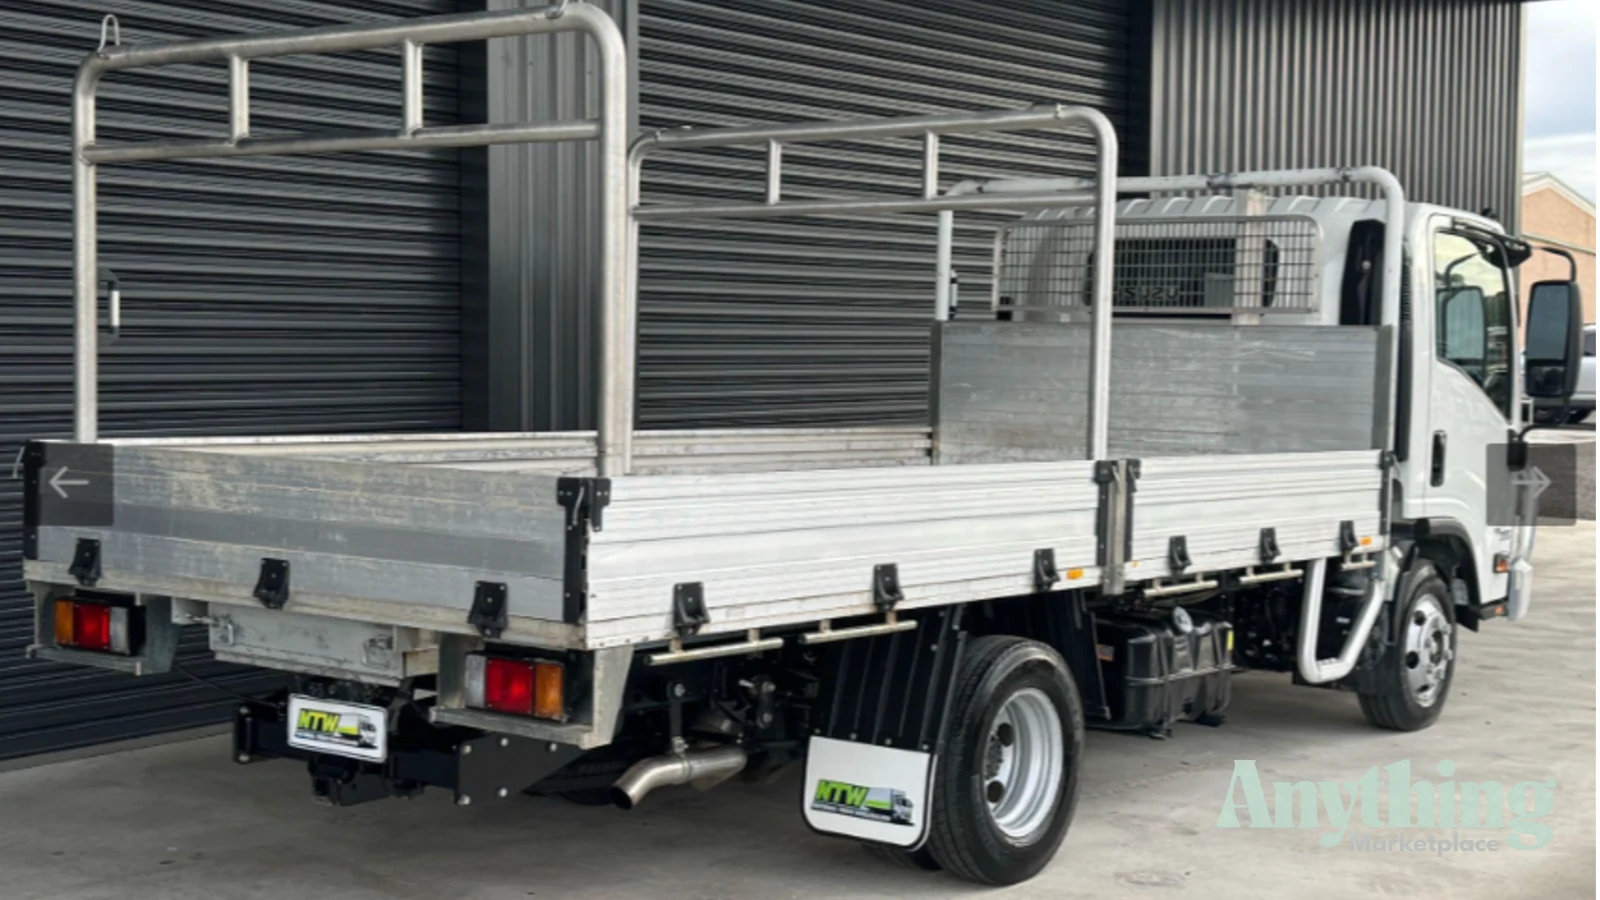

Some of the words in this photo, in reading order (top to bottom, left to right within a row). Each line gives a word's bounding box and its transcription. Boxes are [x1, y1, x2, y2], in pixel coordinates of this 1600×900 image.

[1119, 286, 1178, 300] ISUZU
[297, 709, 340, 733] NTW
[815, 780, 869, 807] NTW
